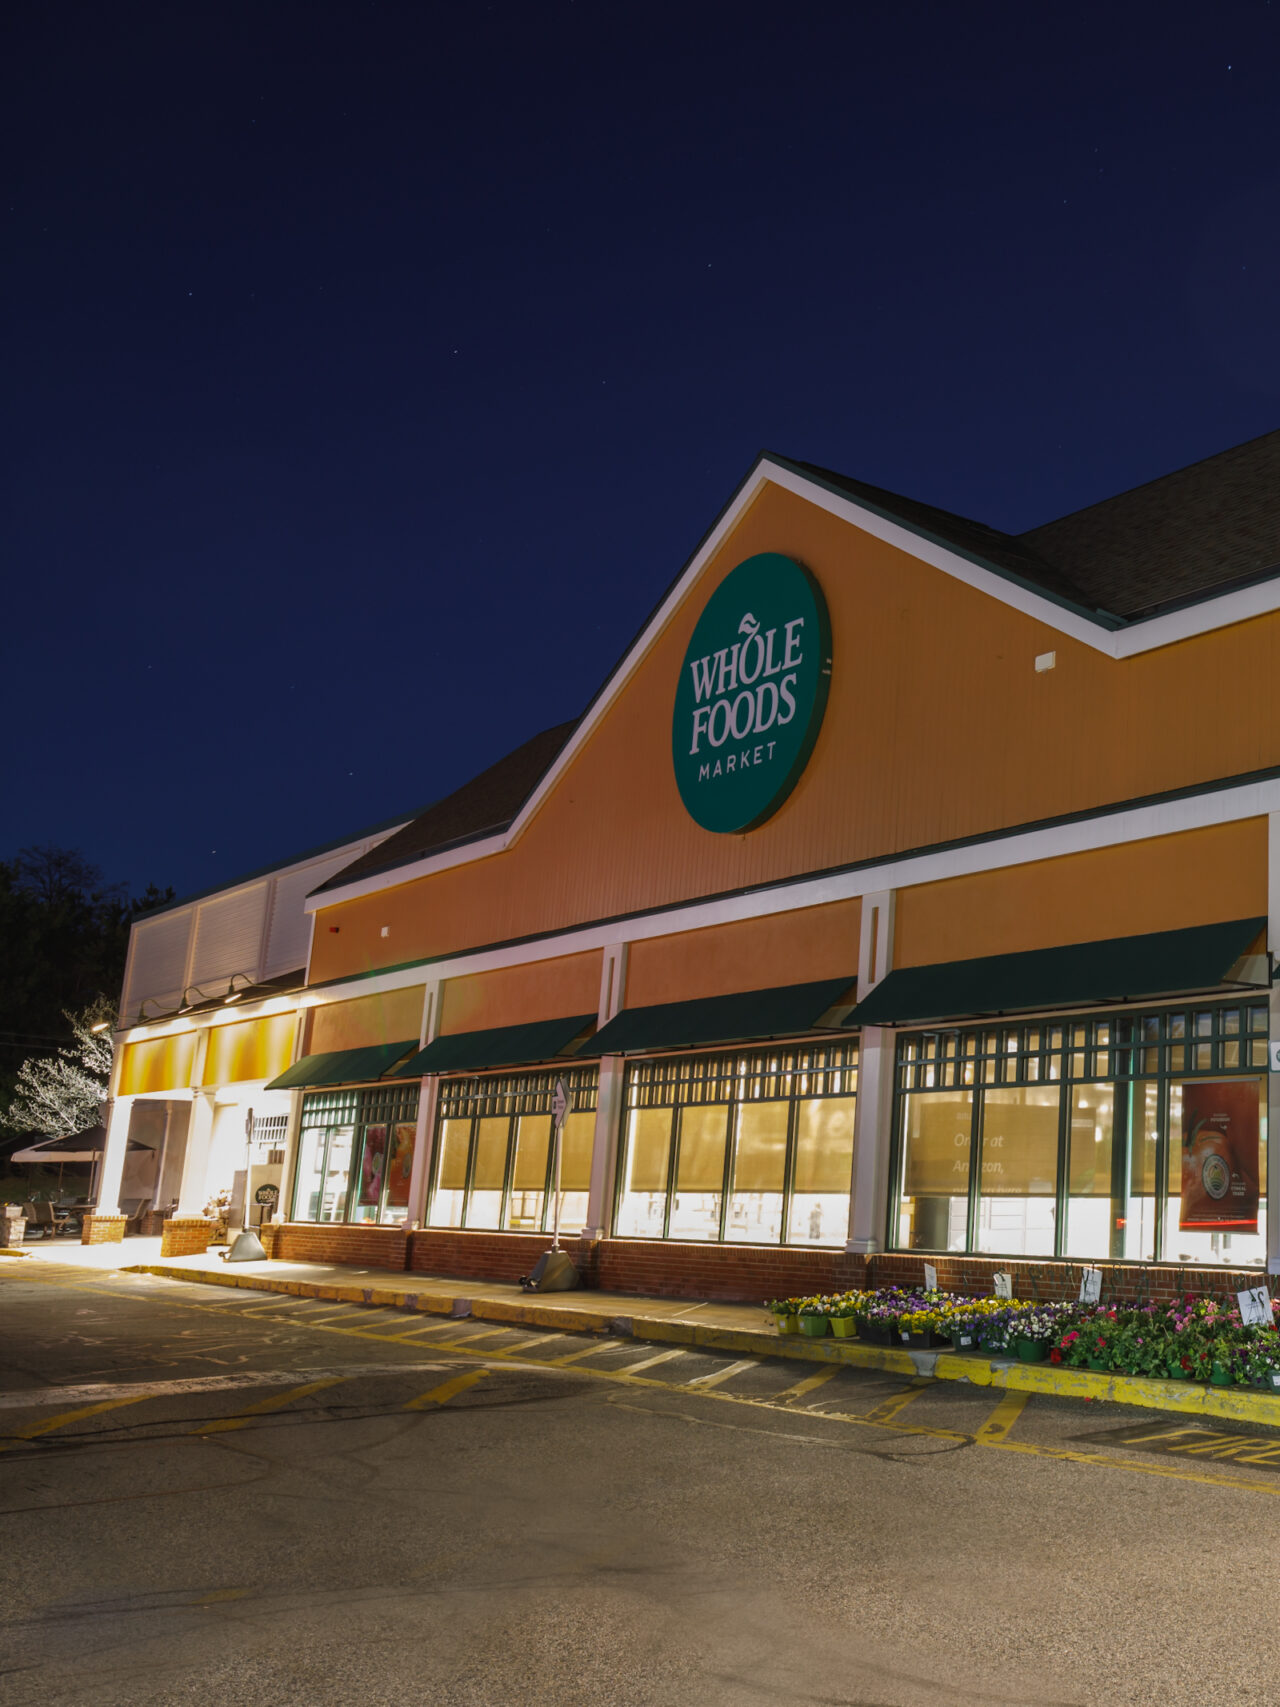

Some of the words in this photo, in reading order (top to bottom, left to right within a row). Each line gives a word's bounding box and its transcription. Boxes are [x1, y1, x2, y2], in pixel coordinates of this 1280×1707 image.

[690, 613, 804, 703] WHOLE
[689, 673, 797, 755] FOODS
[698, 741, 776, 782] MARKET
[990, 1136, 1004, 1147] at
